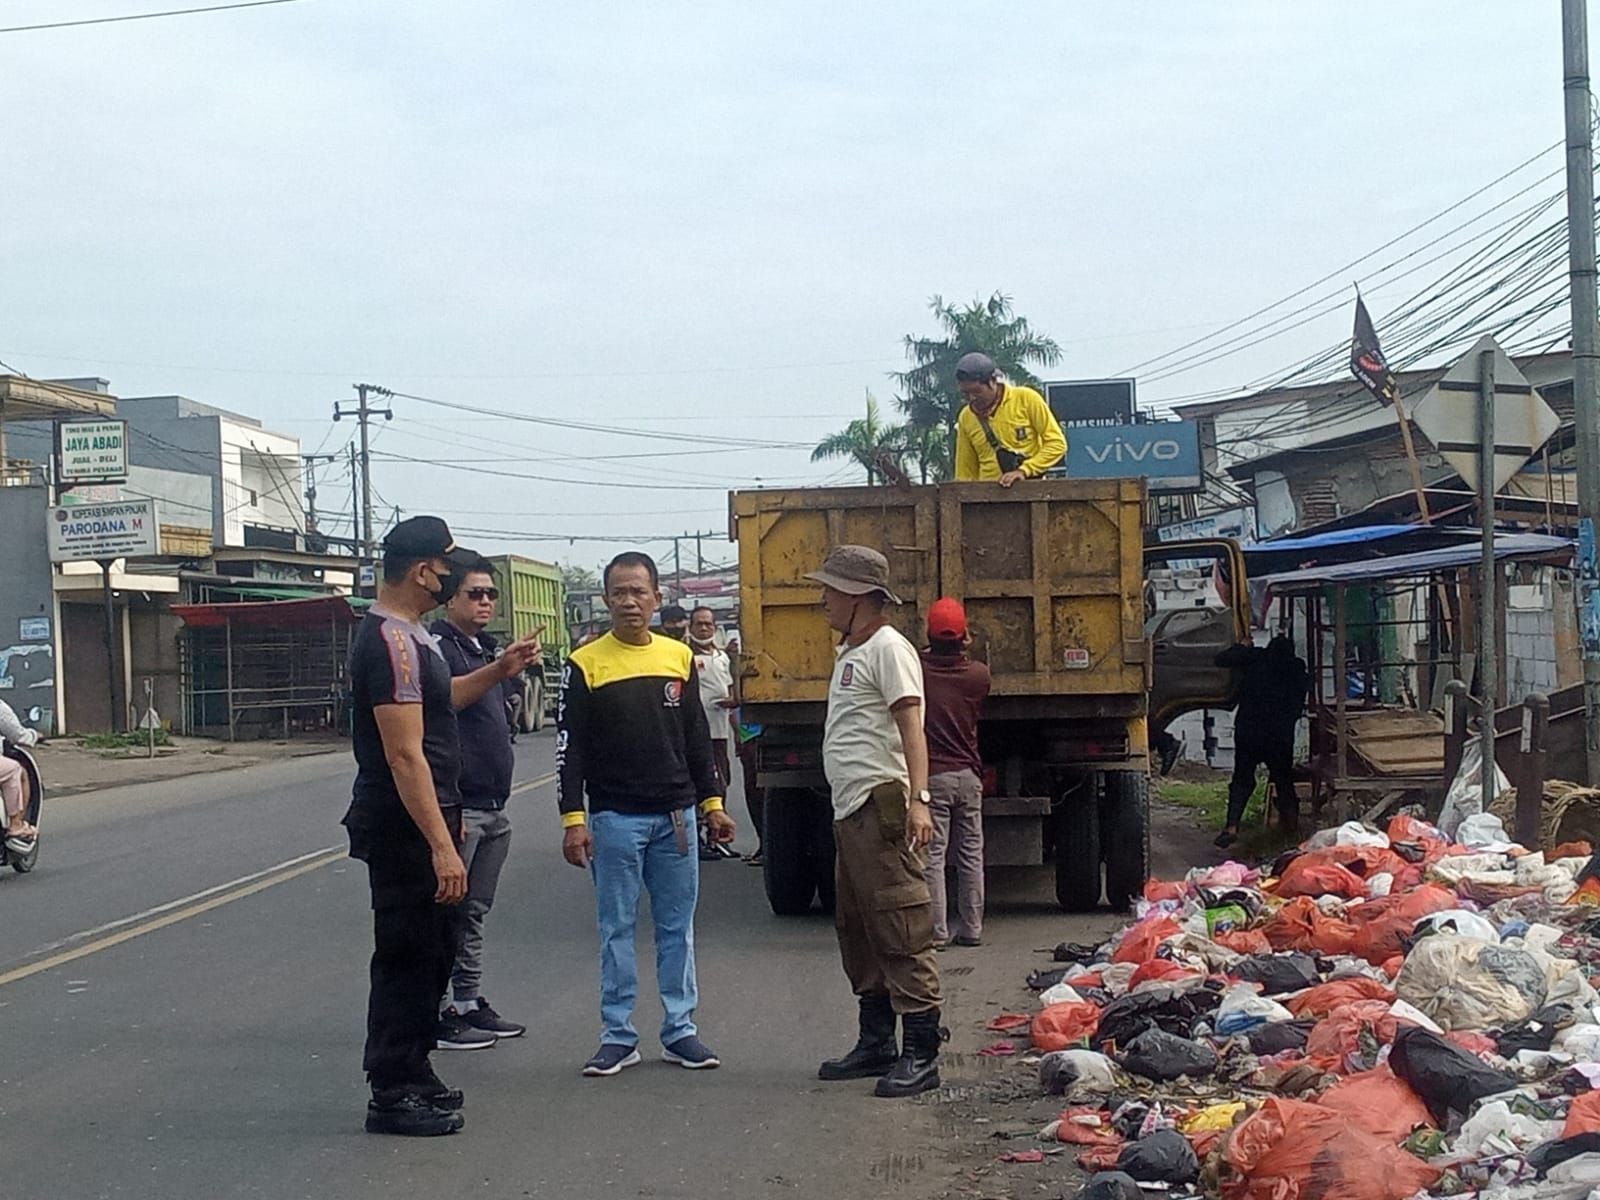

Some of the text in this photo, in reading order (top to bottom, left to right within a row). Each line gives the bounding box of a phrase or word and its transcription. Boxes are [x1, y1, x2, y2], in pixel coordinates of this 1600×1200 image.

[65, 435, 122, 451] JAYA ABADI
[60, 518, 143, 536] PARODANA M
